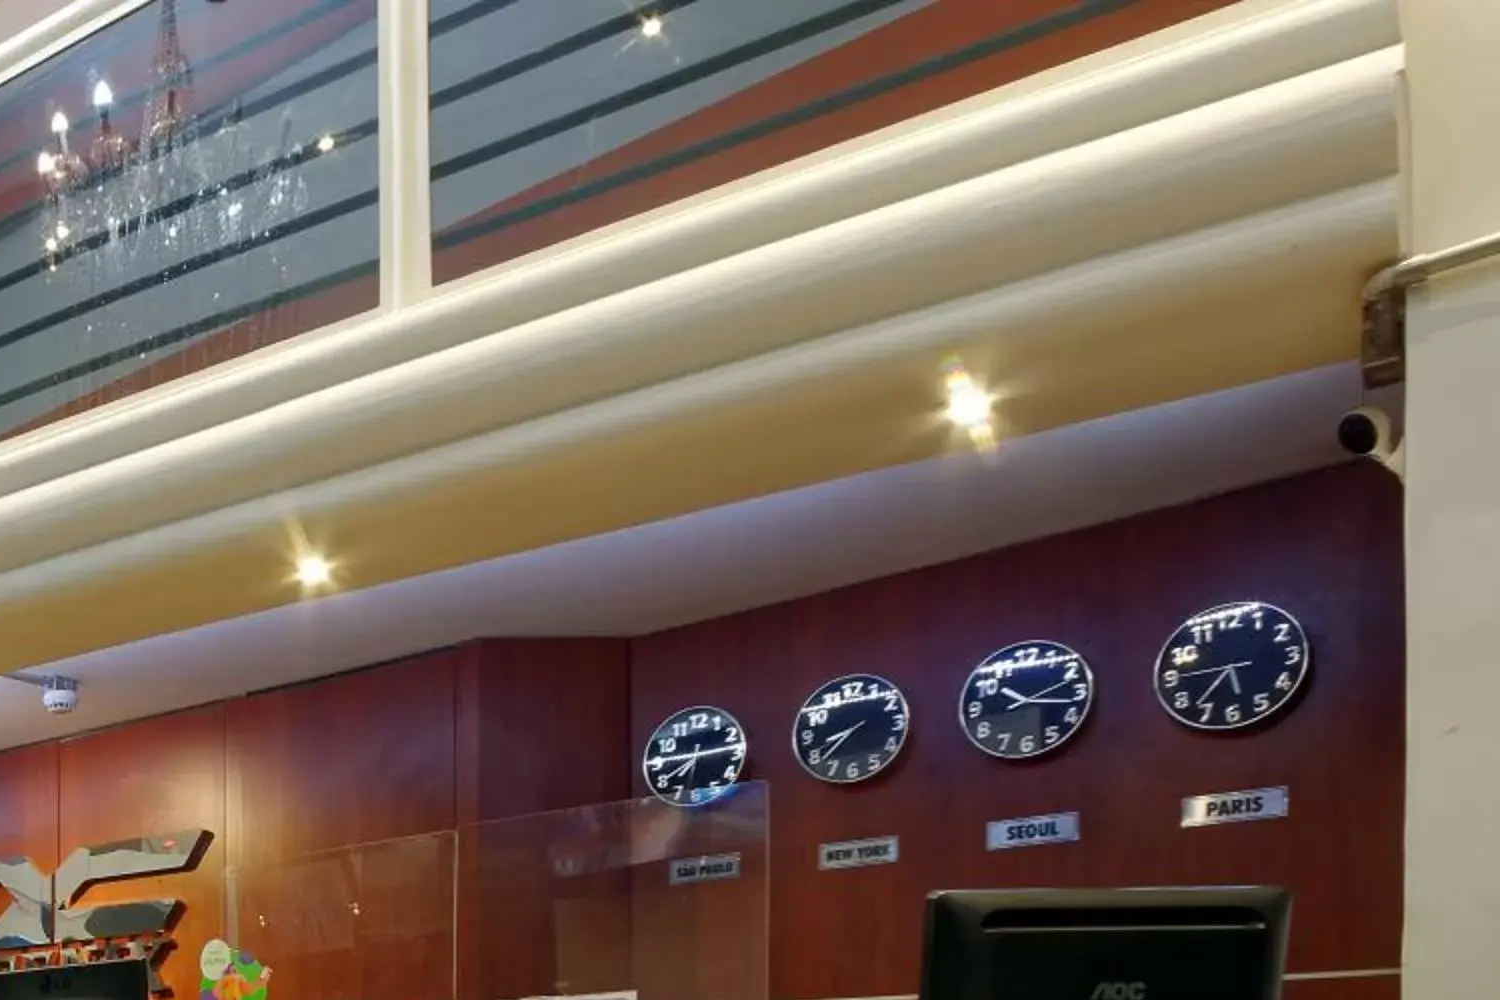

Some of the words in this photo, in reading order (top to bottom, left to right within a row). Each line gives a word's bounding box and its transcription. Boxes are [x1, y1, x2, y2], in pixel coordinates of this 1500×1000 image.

[1218, 611, 1244, 630] 12
[1252, 611, 1264, 630] 1
[1190, 622, 1214, 644] 11
[1273, 623, 1290, 642] 2
[1284, 645, 1300, 665] 3
[1064, 661, 1079, 680] 2
[1163, 669, 1180, 688] 9
[975, 678, 998, 698] 10
[1275, 671, 1292, 690] 4
[1072, 683, 1087, 700] 3
[1174, 691, 1189, 709] 8
[883, 694, 899, 712] 2
[968, 701, 982, 719] 9
[1253, 692, 1270, 712] 5
[689, 713, 708, 728] 12
[808, 710, 828, 727] 10
[1064, 706, 1078, 724] 4
[1198, 702, 1214, 723] 7
[1224, 704, 1240, 722] 6
[672, 722, 688, 737] 11
[712, 715, 721, 731] 1
[892, 714, 904, 730] 3
[724, 726, 738, 742] 2
[802, 730, 814, 745] 9
[997, 733, 1012, 751] 7
[1044, 725, 1060, 744] 5
[658, 738, 677, 752] 10
[884, 736, 896, 752] 4
[1019, 736, 1034, 752] 6
[808, 749, 820, 765] 8
[868, 754, 881, 770] 5
[724, 765, 737, 782] 4
[827, 760, 839, 776] 7
[846, 762, 859, 778] 6
[657, 774, 668, 788] 8
[673, 785, 684, 800] 7
[1206, 796, 1264, 817] PARIS
[1006, 821, 1059, 841] SEOUL
[826, 848, 852, 861] NEW
[858, 844, 891, 858] YORK
[1090, 981, 1146, 1000] AOC
